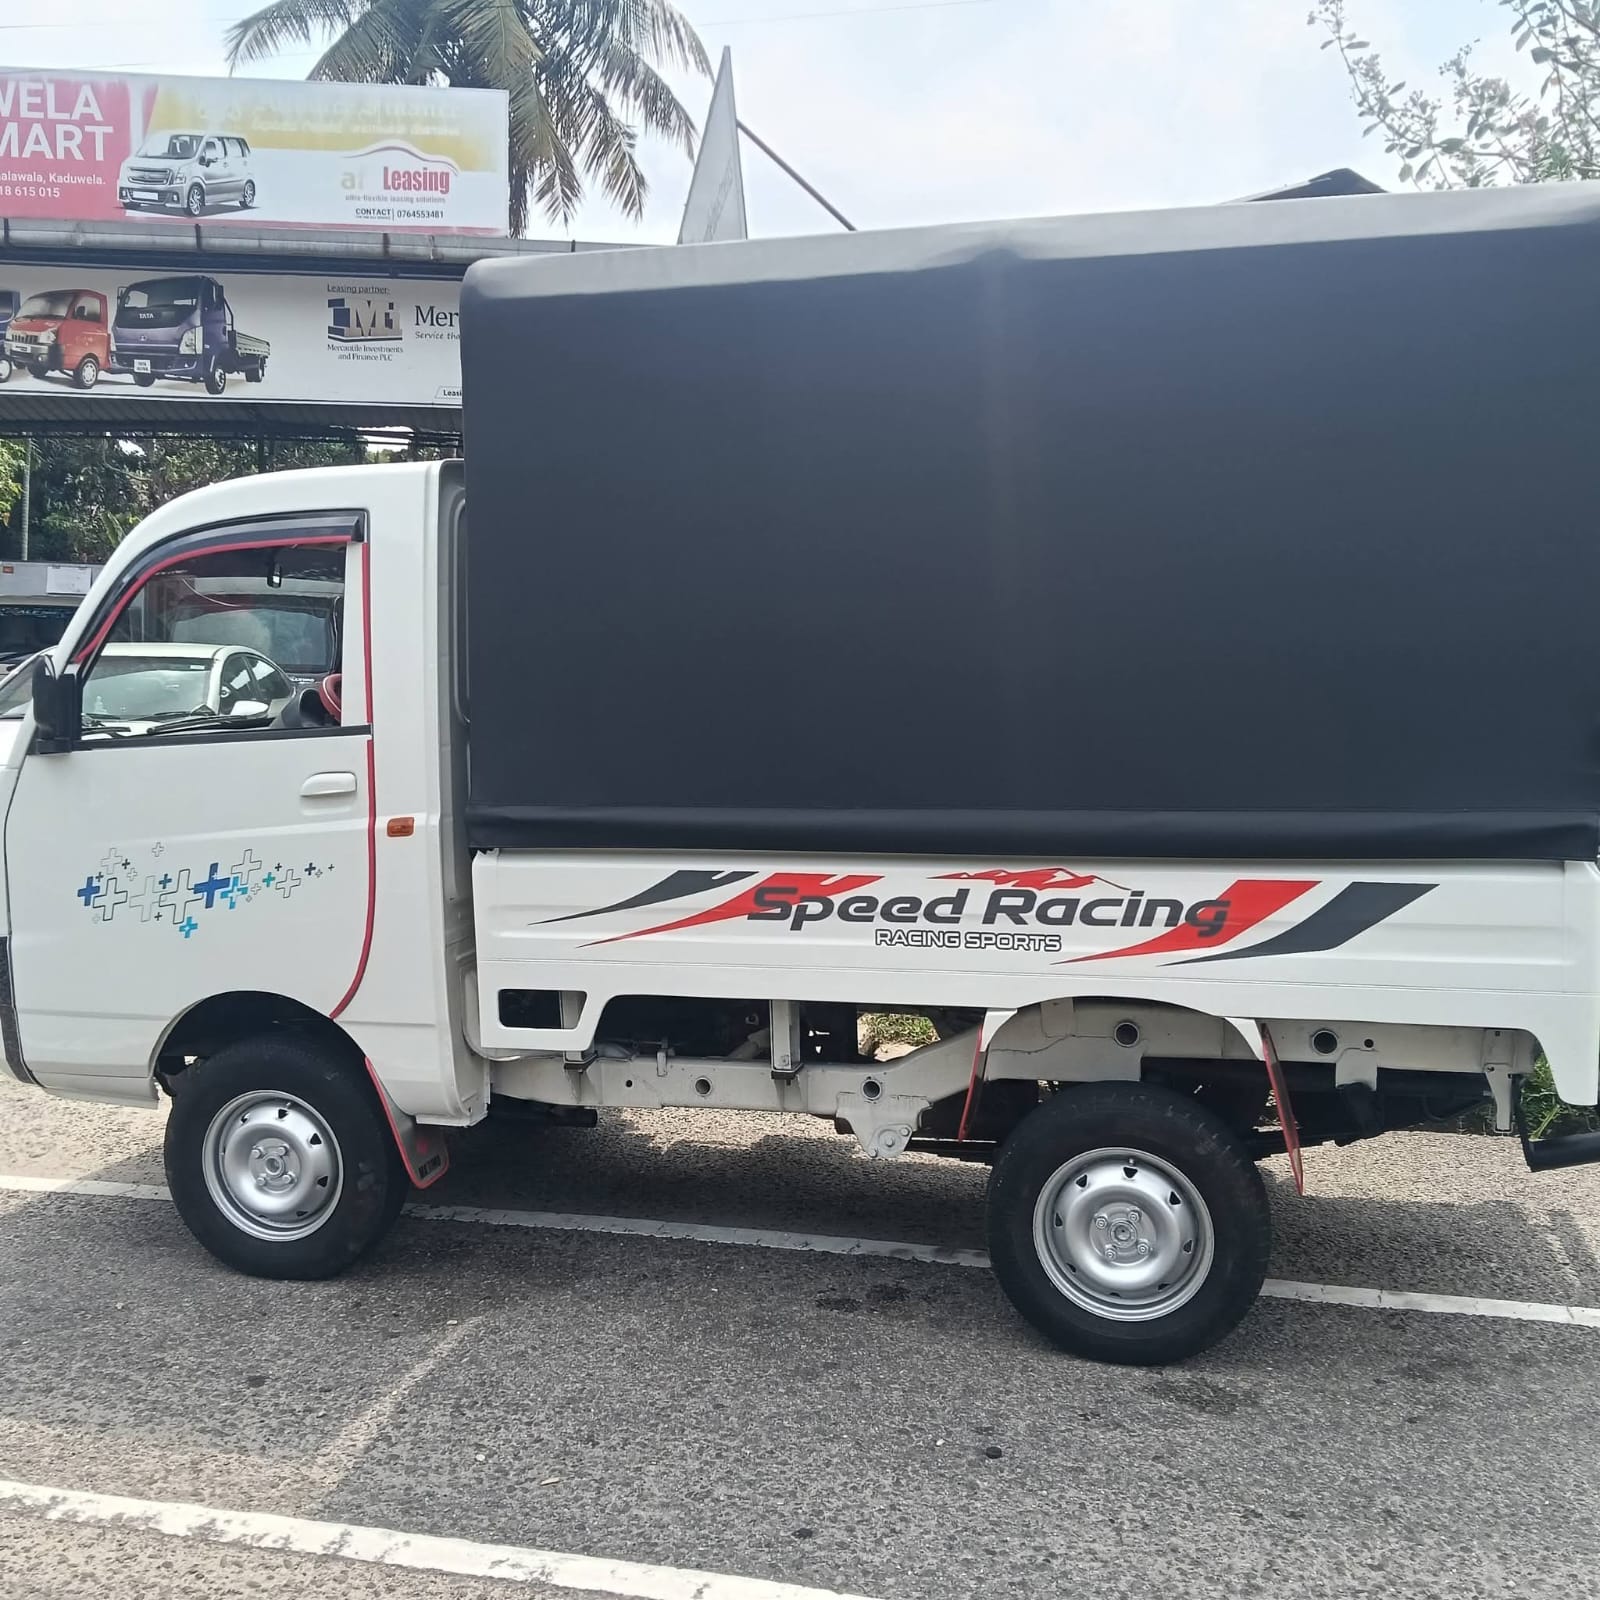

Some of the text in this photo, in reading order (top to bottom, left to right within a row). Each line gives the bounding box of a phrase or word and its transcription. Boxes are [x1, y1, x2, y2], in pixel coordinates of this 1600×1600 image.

[0, 171, 106, 185] alawala, Kaduwela.
[383, 166, 450, 195] Leasing
[14, 186, 36, 197] 615
[38, 187, 60, 198] 015
[355, 208, 391, 216] CONTACT
[327, 284, 357, 295] Leasing
[415, 330, 444, 340] Service
[327, 343, 404, 354] Mercantile Investments
[338, 352, 351, 361] and
[352, 353, 379, 361] Finance
[747, 887, 1231, 937] Speed Racing
[875, 929, 1062, 952] RACING SPORTS
